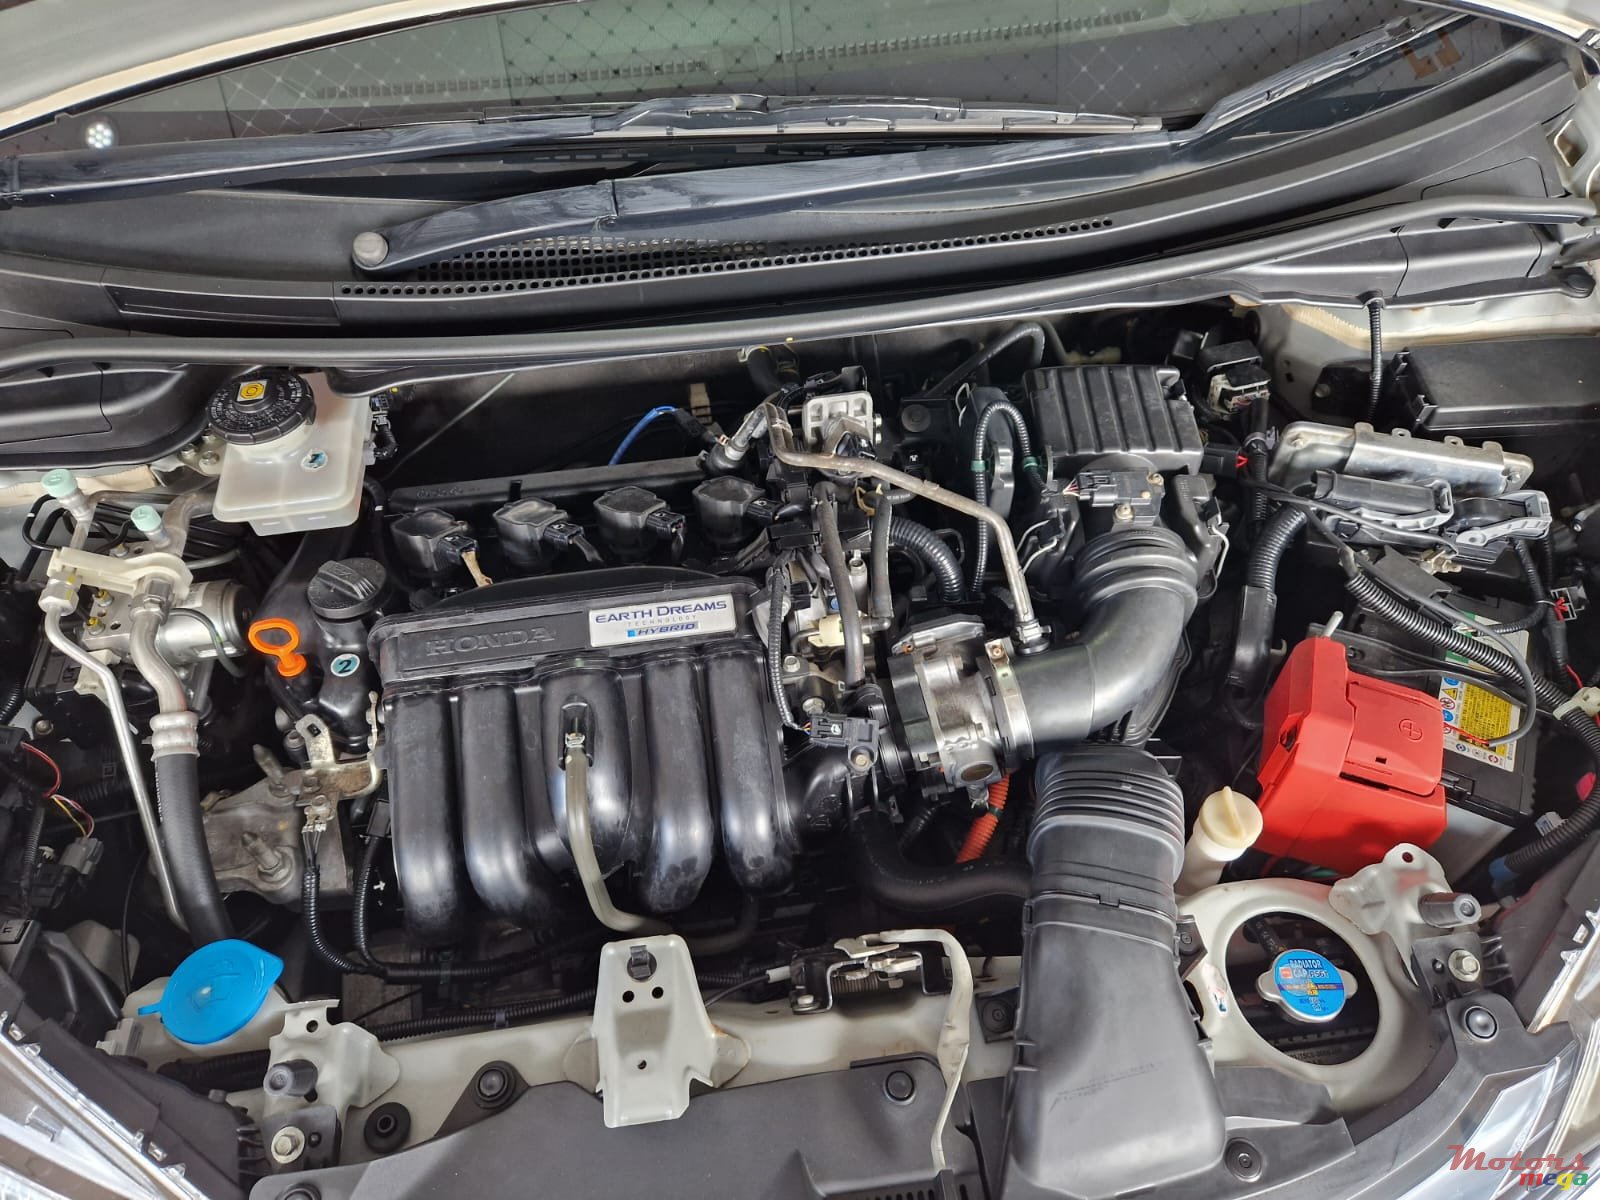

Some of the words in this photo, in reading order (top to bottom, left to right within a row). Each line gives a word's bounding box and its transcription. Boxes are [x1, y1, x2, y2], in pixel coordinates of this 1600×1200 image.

[595, 608, 653, 624] EARTH
[656, 600, 727, 617] DREAMS
[627, 614, 697, 627] TECHNOLOGY
[637, 623, 696, 636] HYBRID
[426, 627, 556, 657] HONDA
[338, 659, 352, 674] 2
[1289, 959, 1322, 969] RADIATOR
